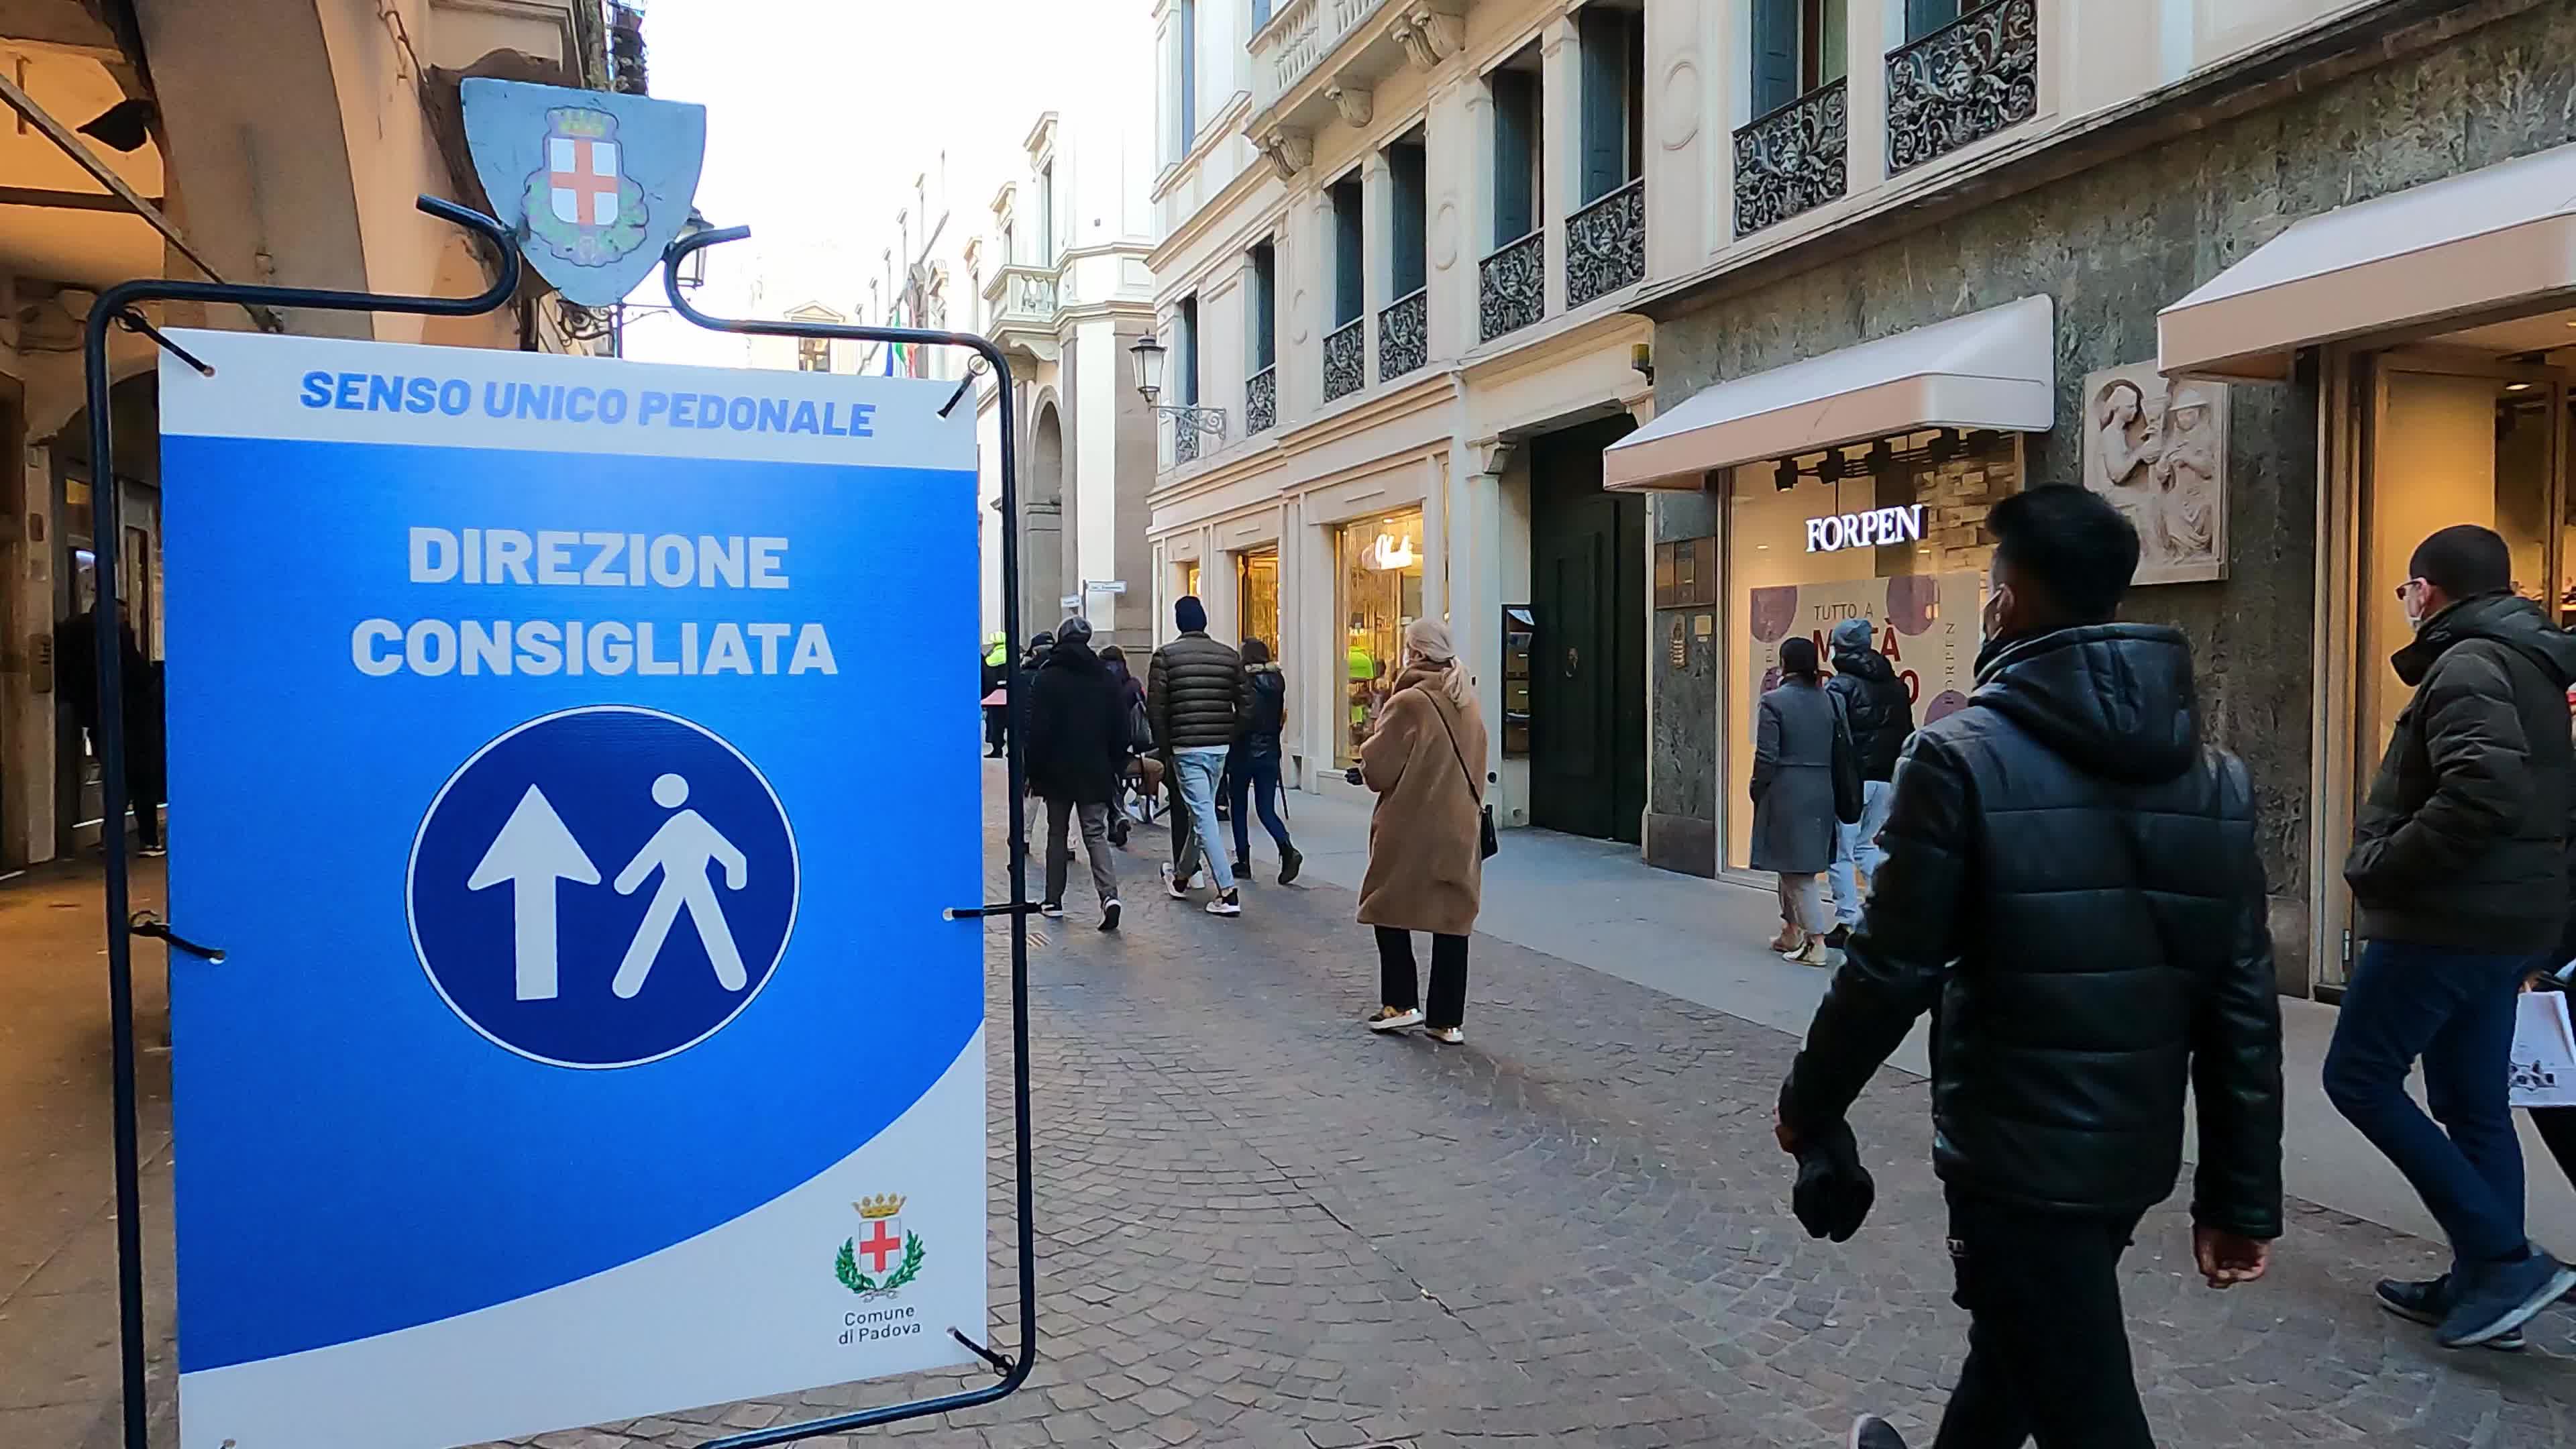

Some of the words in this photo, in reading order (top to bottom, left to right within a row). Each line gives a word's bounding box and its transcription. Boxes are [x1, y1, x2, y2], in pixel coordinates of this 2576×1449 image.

[299, 370, 472, 415] SENSO
[483, 380, 627, 425] UNICO
[638, 390, 877, 437] PEDONALE
[1805, 504, 1923, 553] FORPEN
[409, 527, 790, 590] DIREZIONE
[1814, 603, 1858, 621] TUTTO
[1865, 602, 1874, 618] A
[352, 618, 839, 676] CONSIGLIATA
[1813, 618, 1901, 662] MÀ
[839, 1328, 853, 1344] di
[859, 1323, 920, 1342] Padova
[845, 1307, 915, 1326] Comune
